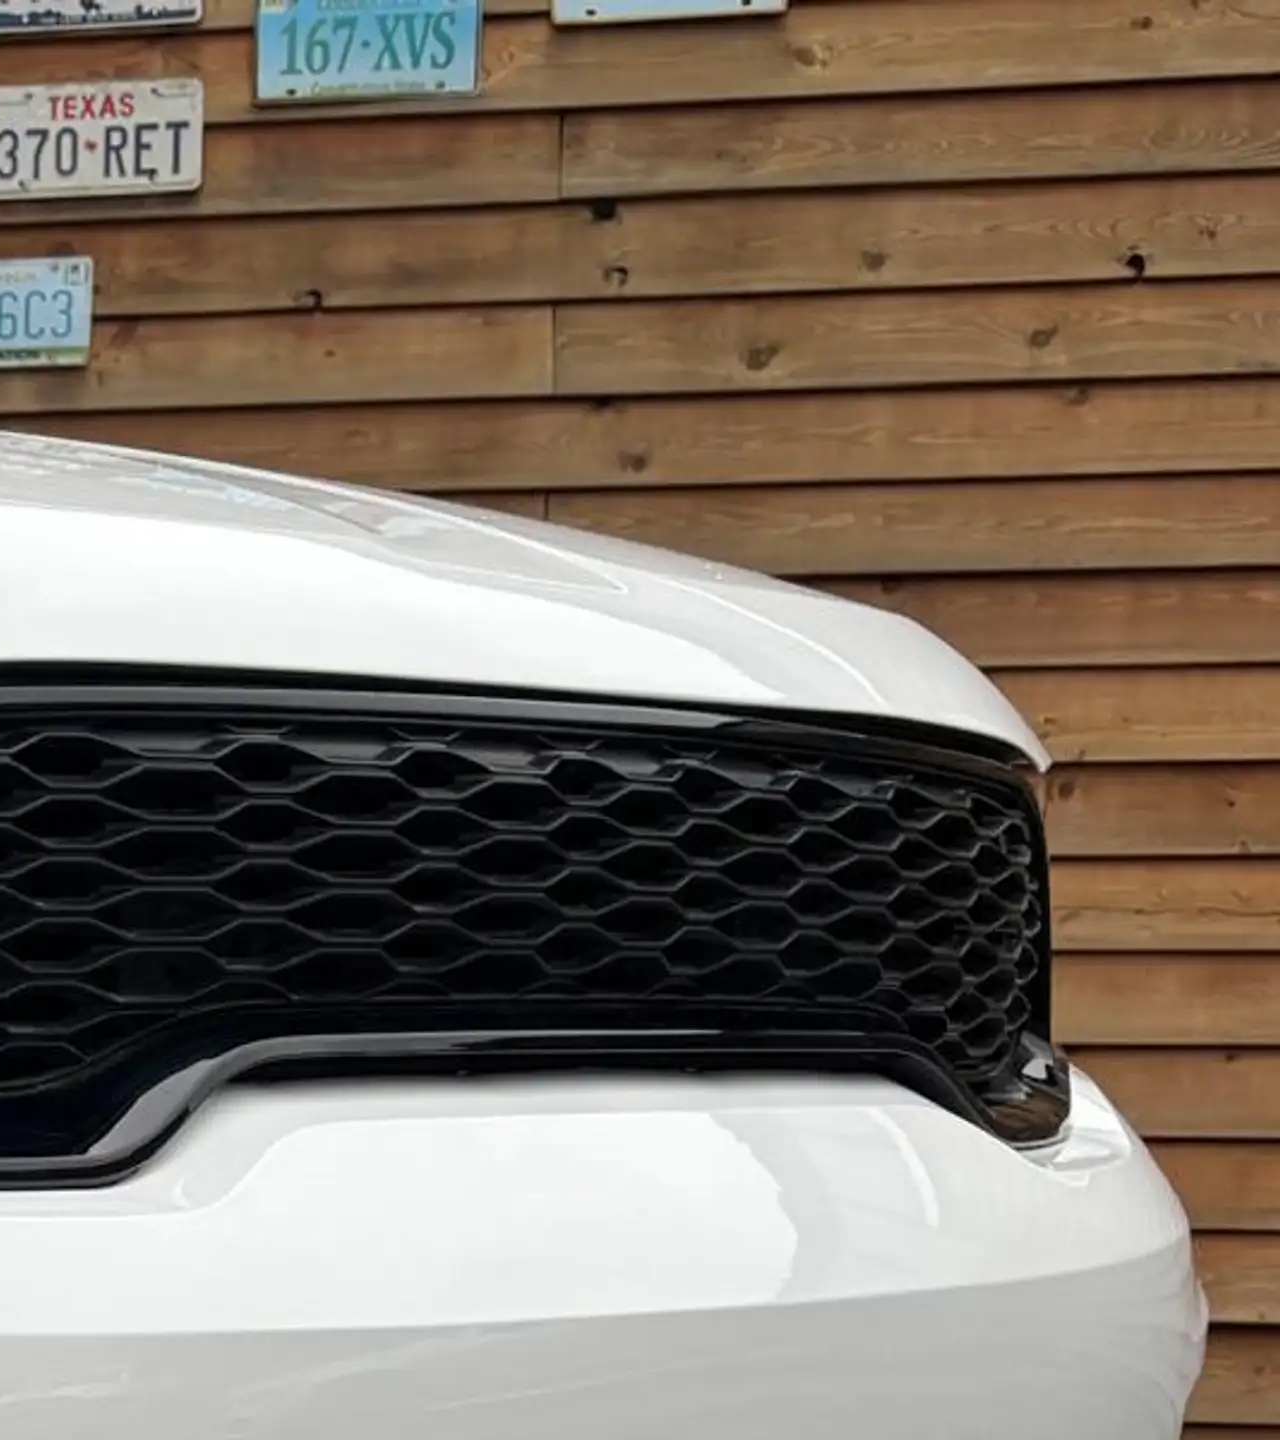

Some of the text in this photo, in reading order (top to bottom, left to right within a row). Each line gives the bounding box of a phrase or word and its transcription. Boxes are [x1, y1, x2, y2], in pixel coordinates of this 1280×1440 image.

[278, 11, 456, 76] 167 XVS
[48, 92, 137, 121] TEXAS
[102, 120, 190, 180] RET
